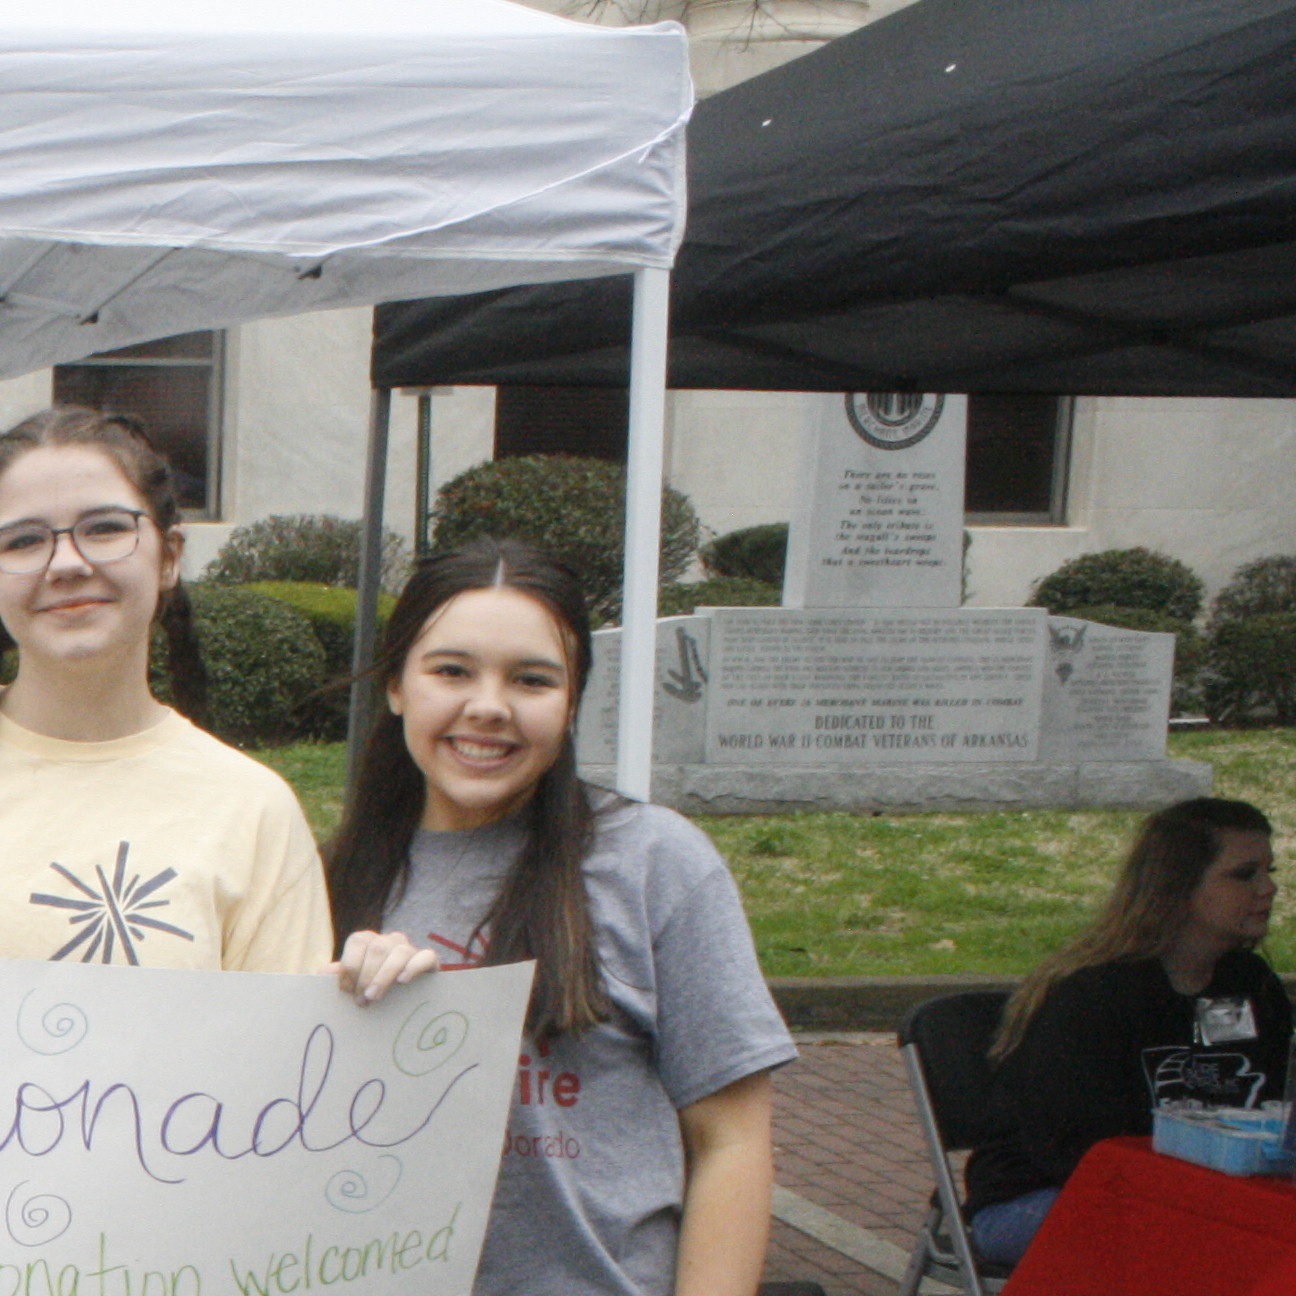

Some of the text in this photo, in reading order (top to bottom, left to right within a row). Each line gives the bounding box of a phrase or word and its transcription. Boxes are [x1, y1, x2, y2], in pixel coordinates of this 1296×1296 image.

[815, 714, 935, 730] DEDICATED TO THE
[718, 733, 1029, 749] WORLD WAR II COMBAT VETERANS OF ARKANSAS
